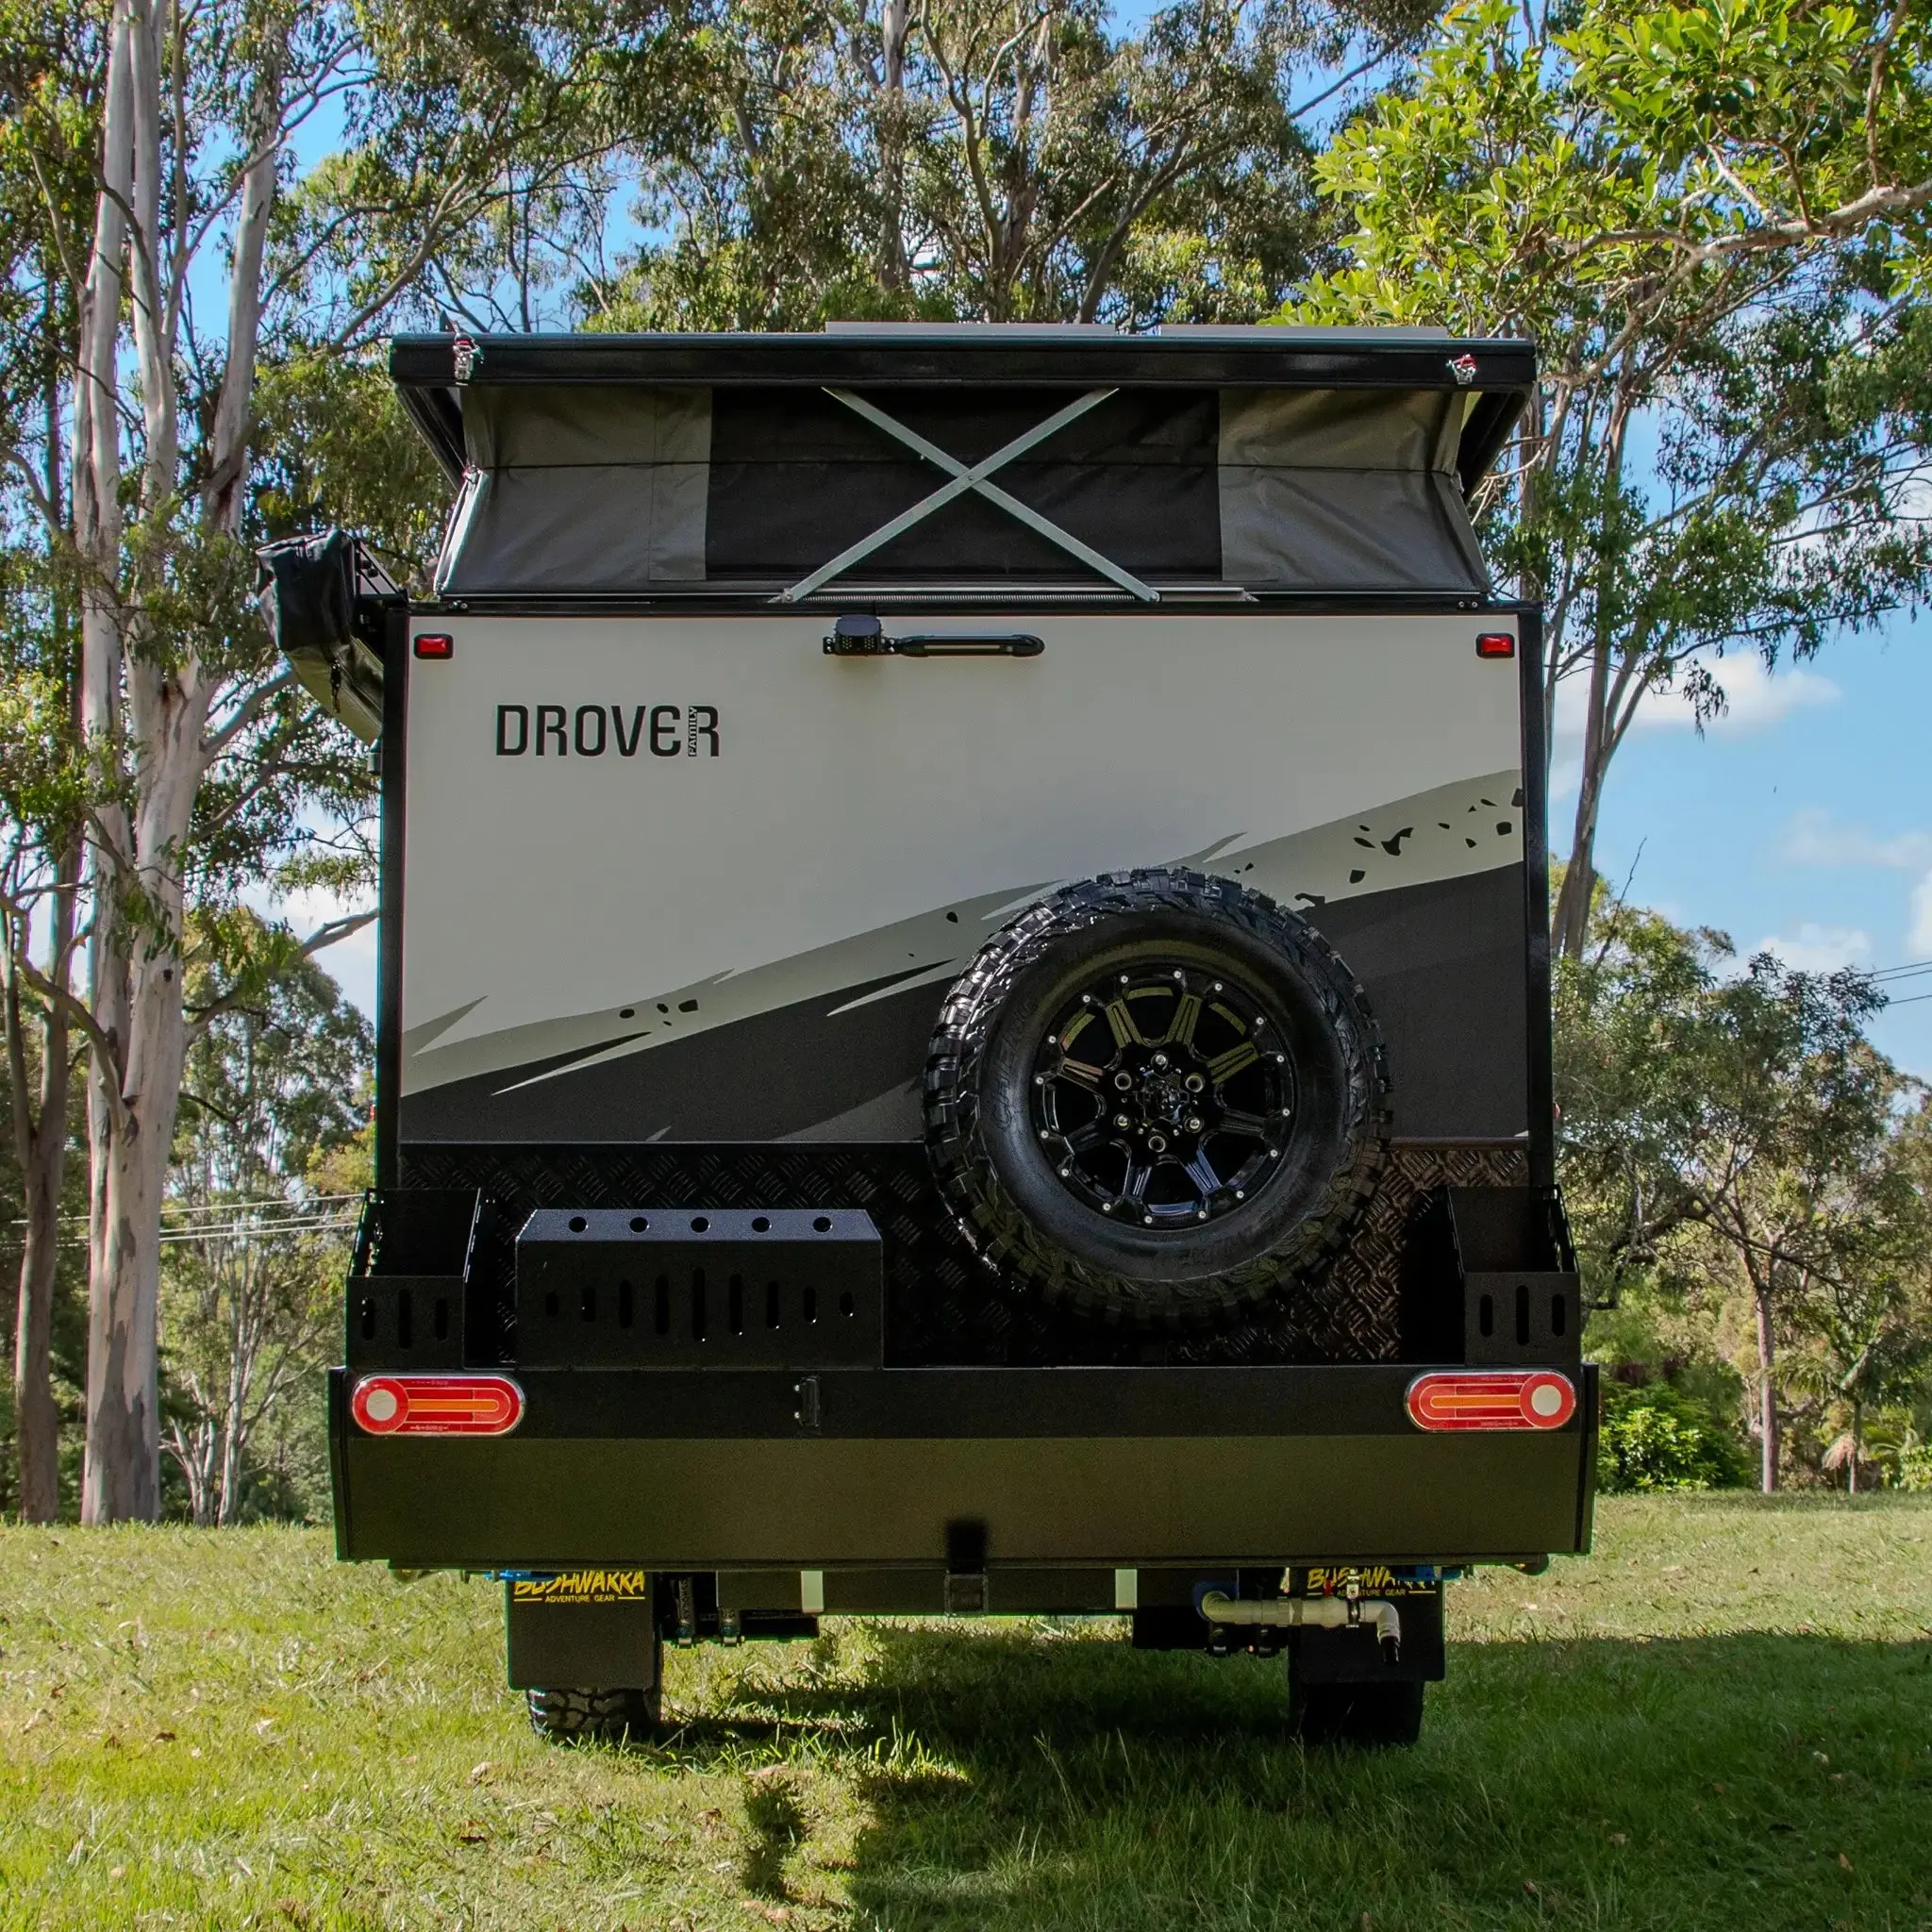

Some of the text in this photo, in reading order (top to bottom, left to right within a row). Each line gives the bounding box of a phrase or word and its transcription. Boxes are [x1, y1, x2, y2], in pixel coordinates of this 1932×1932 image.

[496, 705, 720, 758] DROVER
[688, 707, 697, 756] FAMILY
[545, 1594, 615, 1604] ADVENTURE GEAR
